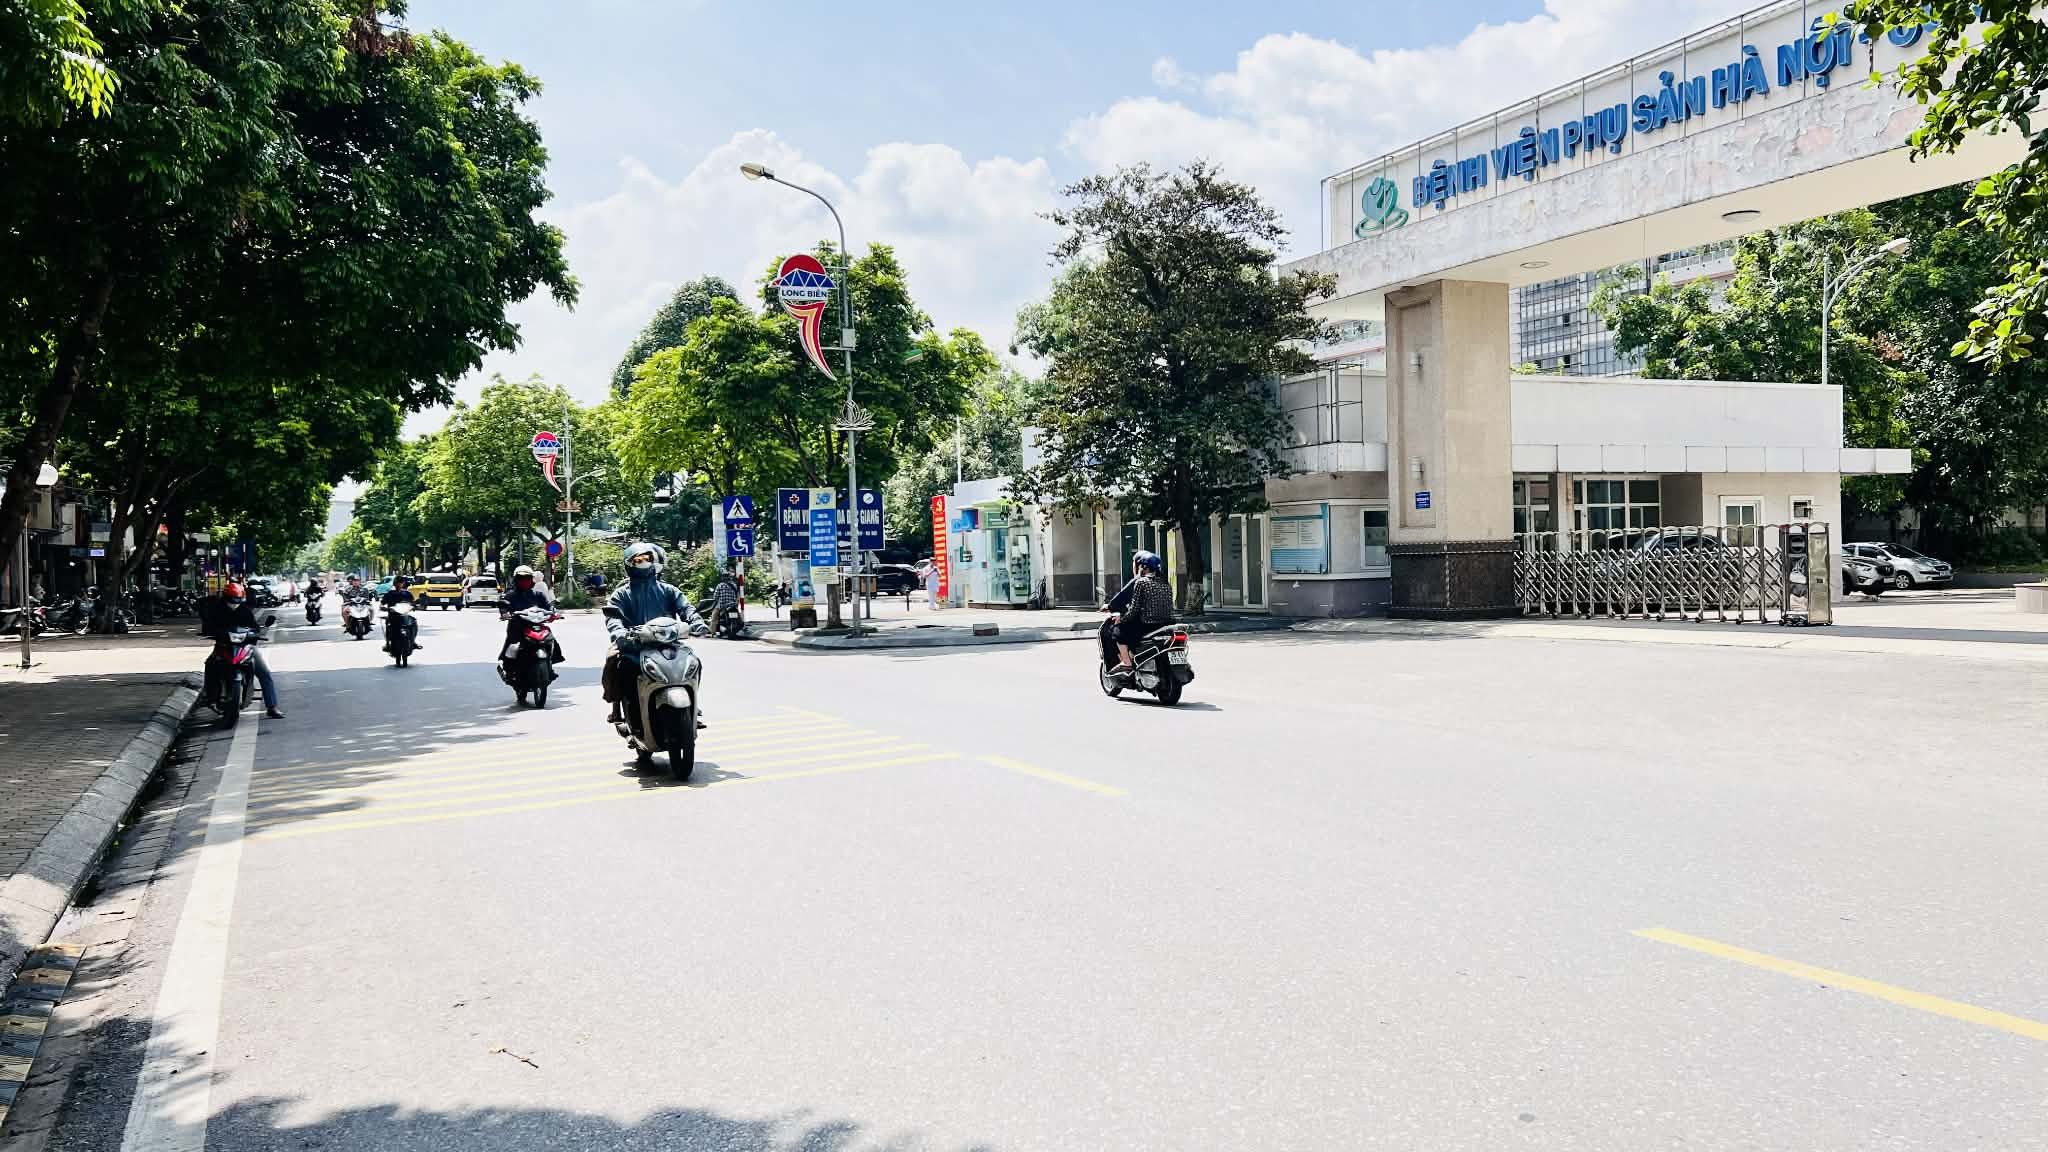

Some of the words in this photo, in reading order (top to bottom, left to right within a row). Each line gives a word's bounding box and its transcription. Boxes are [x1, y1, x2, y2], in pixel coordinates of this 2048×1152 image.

[1413, 159, 1487, 209] BỆNH
[1491, 126, 1559, 181] VIỆN
[1563, 103, 1627, 153] PHỤ
[1632, 71, 1705, 133] SẢN
[1712, 45, 1768, 108] HÀ
[1777, 16, 1851, 87] NỘI
[860, 509, 880, 525] GIANG
